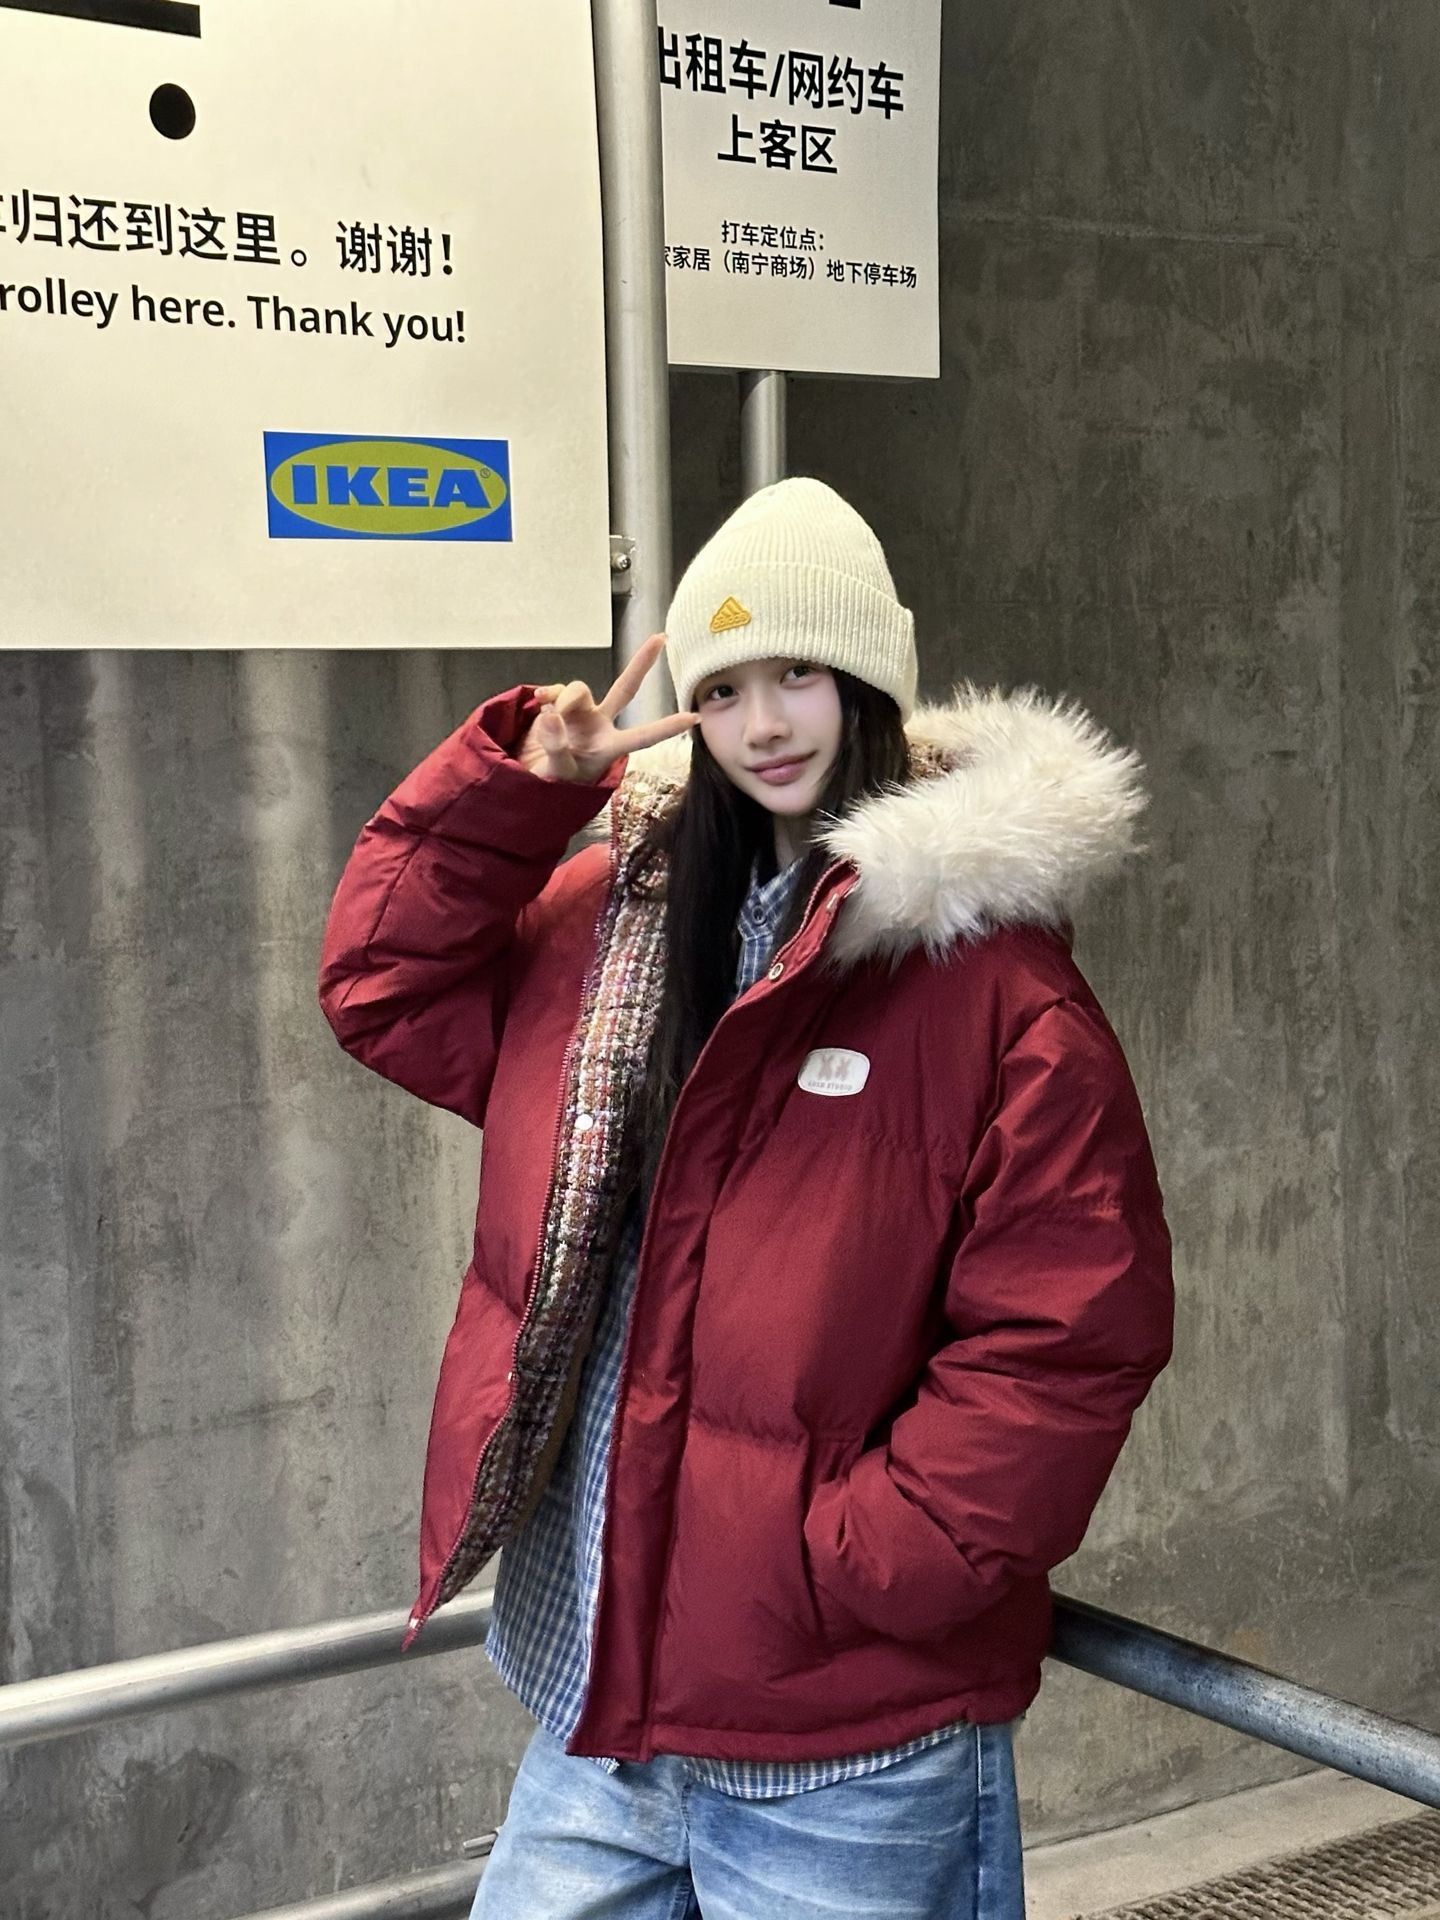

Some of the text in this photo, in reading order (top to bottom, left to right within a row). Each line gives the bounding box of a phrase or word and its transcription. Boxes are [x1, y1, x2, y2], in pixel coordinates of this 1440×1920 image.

[658, 26, 904, 120] 出租车/网约车
[717, 113, 838, 174] 上客区
[0, 188, 453, 278] 归还到这里。谢谢！
[721, 220, 825, 251] 打车定位点：
[131, 284, 236, 328] here.
[246, 295, 375, 337] Thank
[382, 310, 466, 349] you!
[292, 464, 491, 509] IKEA
